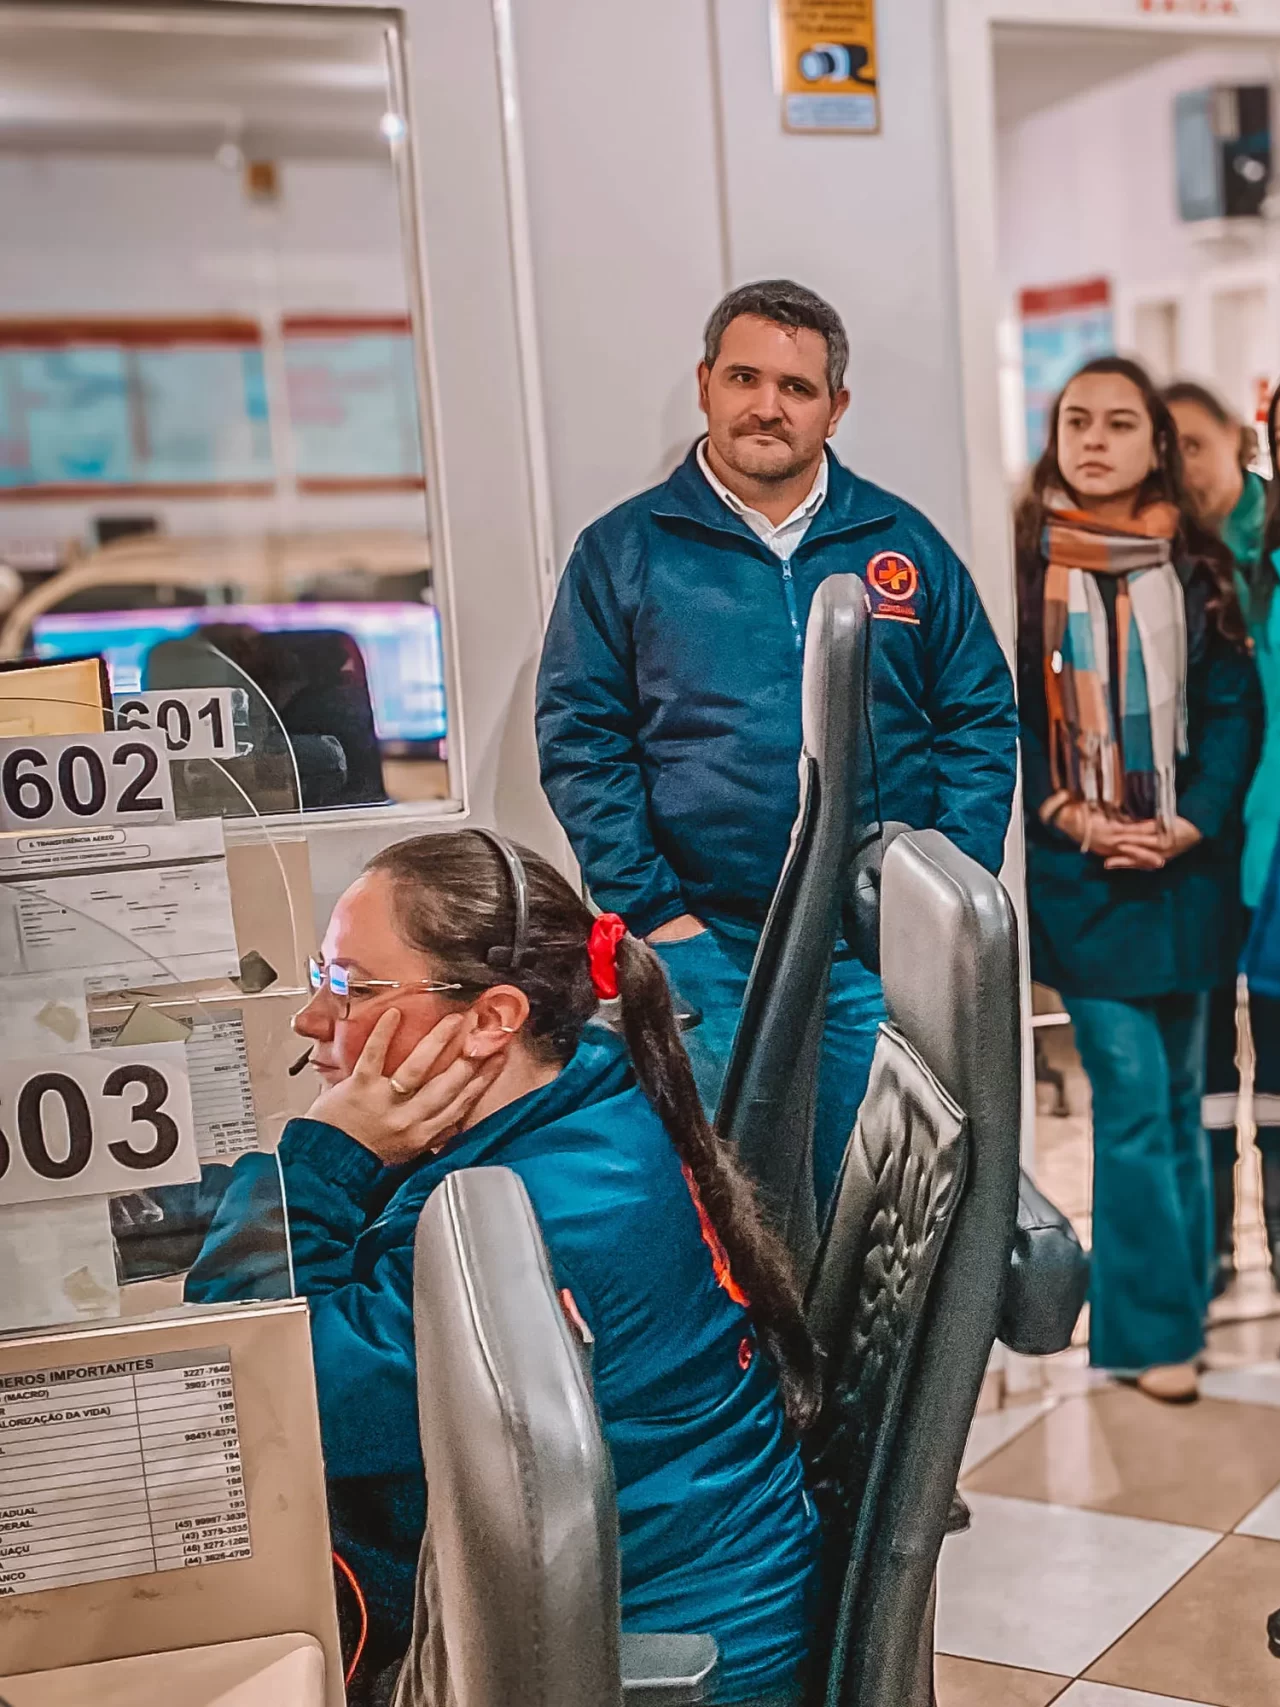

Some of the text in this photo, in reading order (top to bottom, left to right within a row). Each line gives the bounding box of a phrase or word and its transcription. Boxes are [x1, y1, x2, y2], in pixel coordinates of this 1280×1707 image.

[2, 742, 164, 820] 602
[0, 1064, 180, 1180] 03
[50, 1358, 154, 1382] IMPORTANTES
[4, 1389, 49, 1402] (MACRO)
[66, 1411, 81, 1420] DA
[83, 1406, 111, 1417] VIDA)
